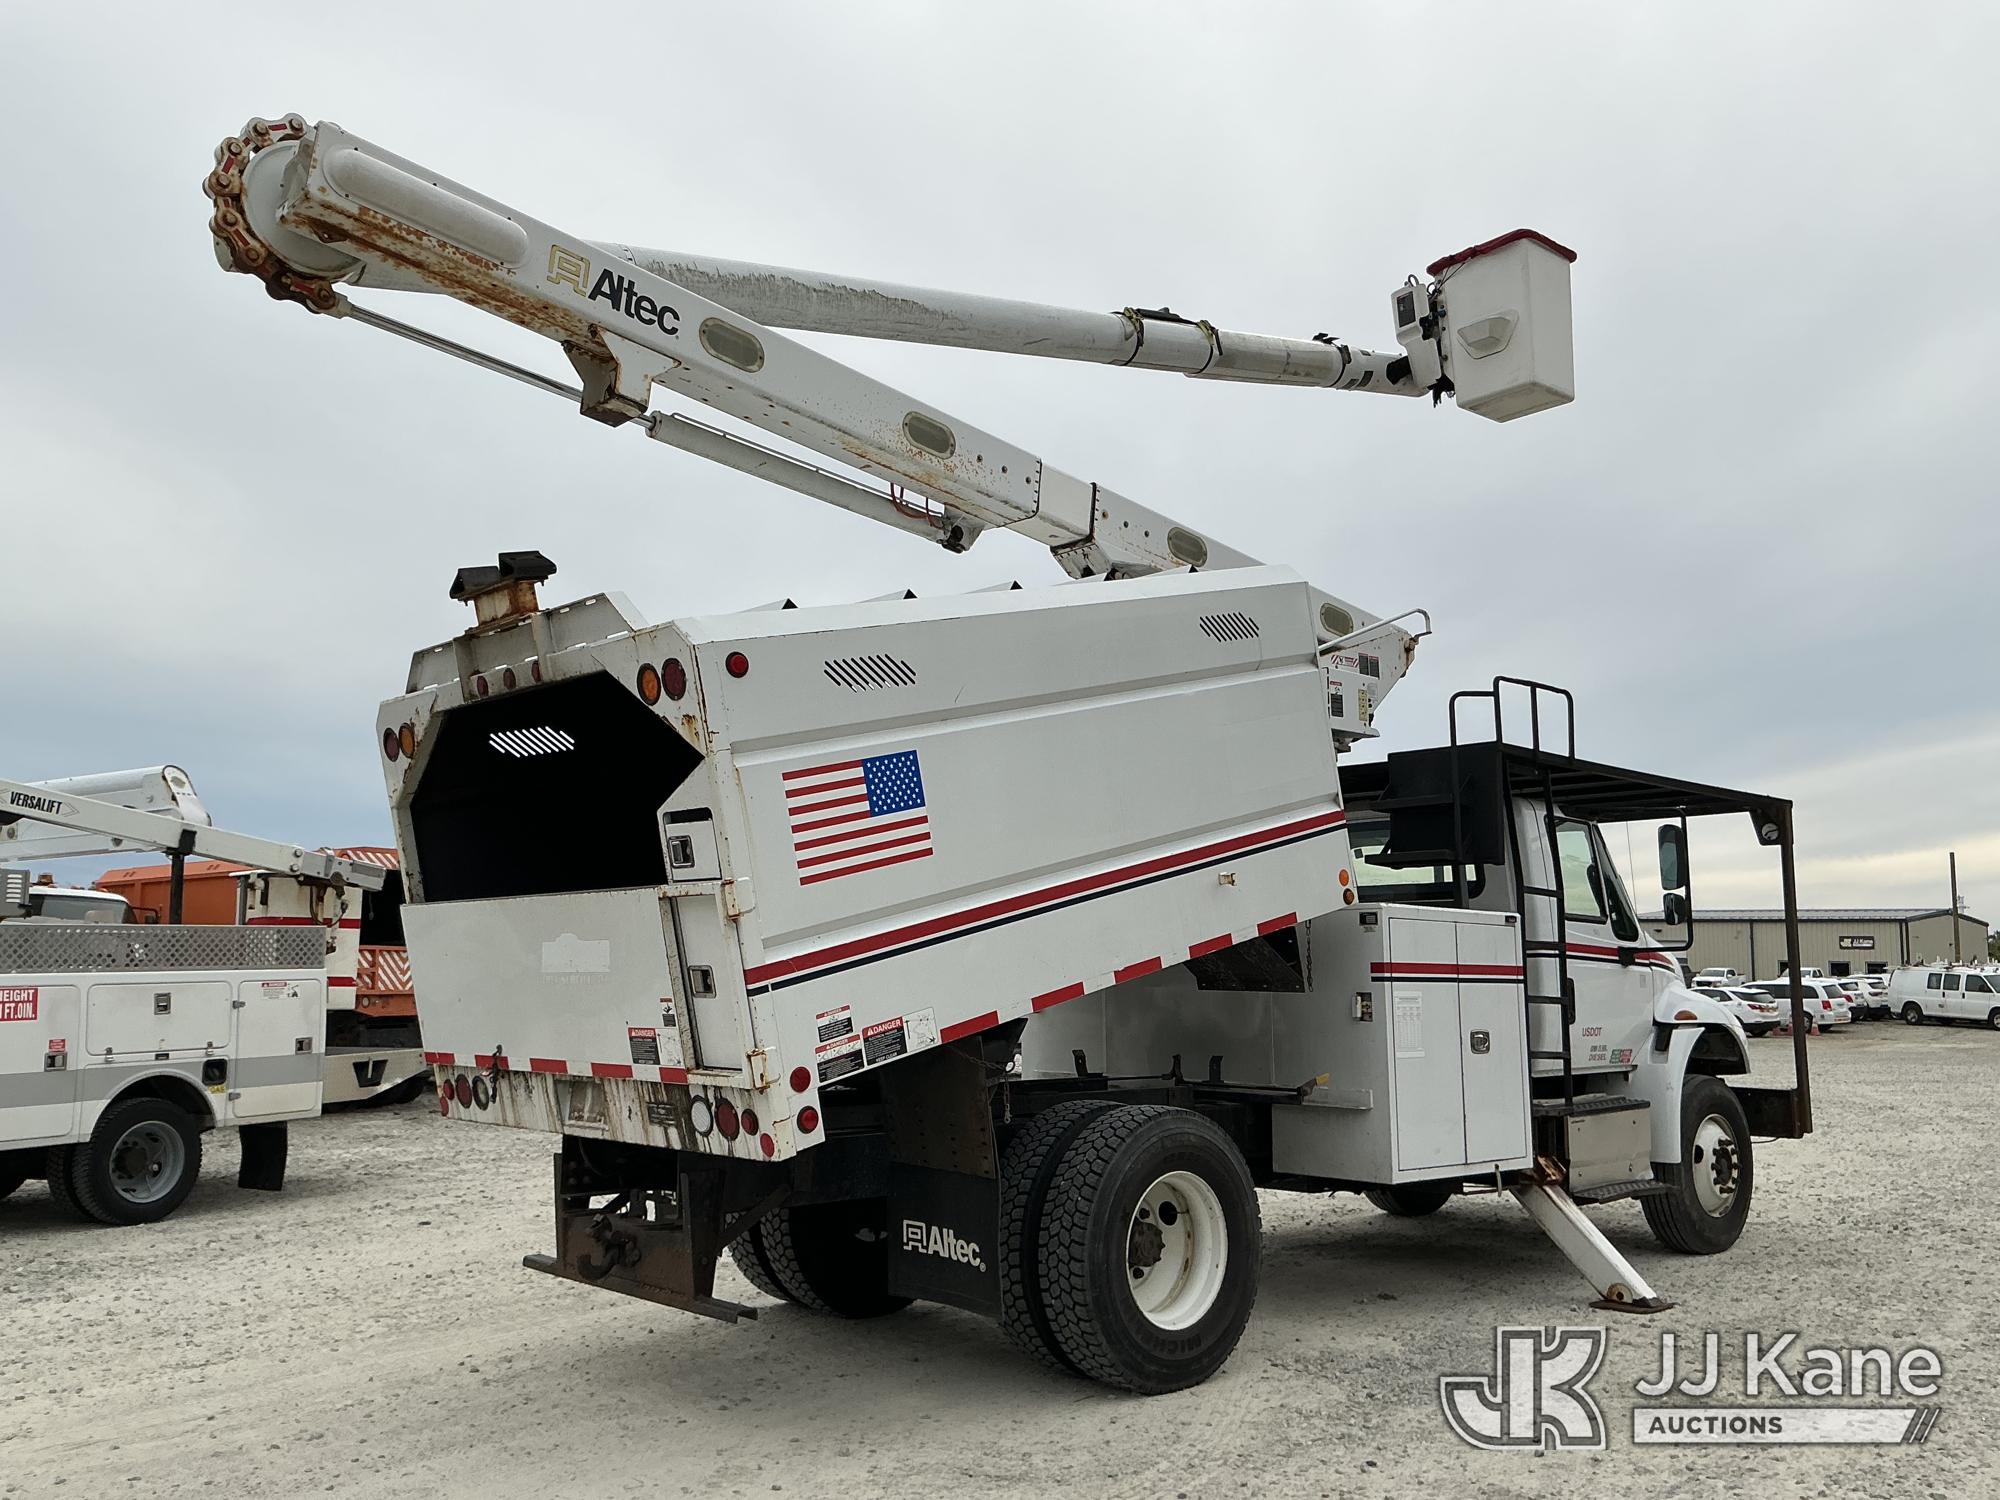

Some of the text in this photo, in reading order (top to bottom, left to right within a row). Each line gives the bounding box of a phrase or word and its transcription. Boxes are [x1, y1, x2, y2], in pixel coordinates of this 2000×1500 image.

[588, 268, 680, 336] Altec
[10, 791, 62, 815] VERSALIFT
[873, 1019, 901, 1034] DANGER
[1582, 1027, 1602, 1037] USDOT
